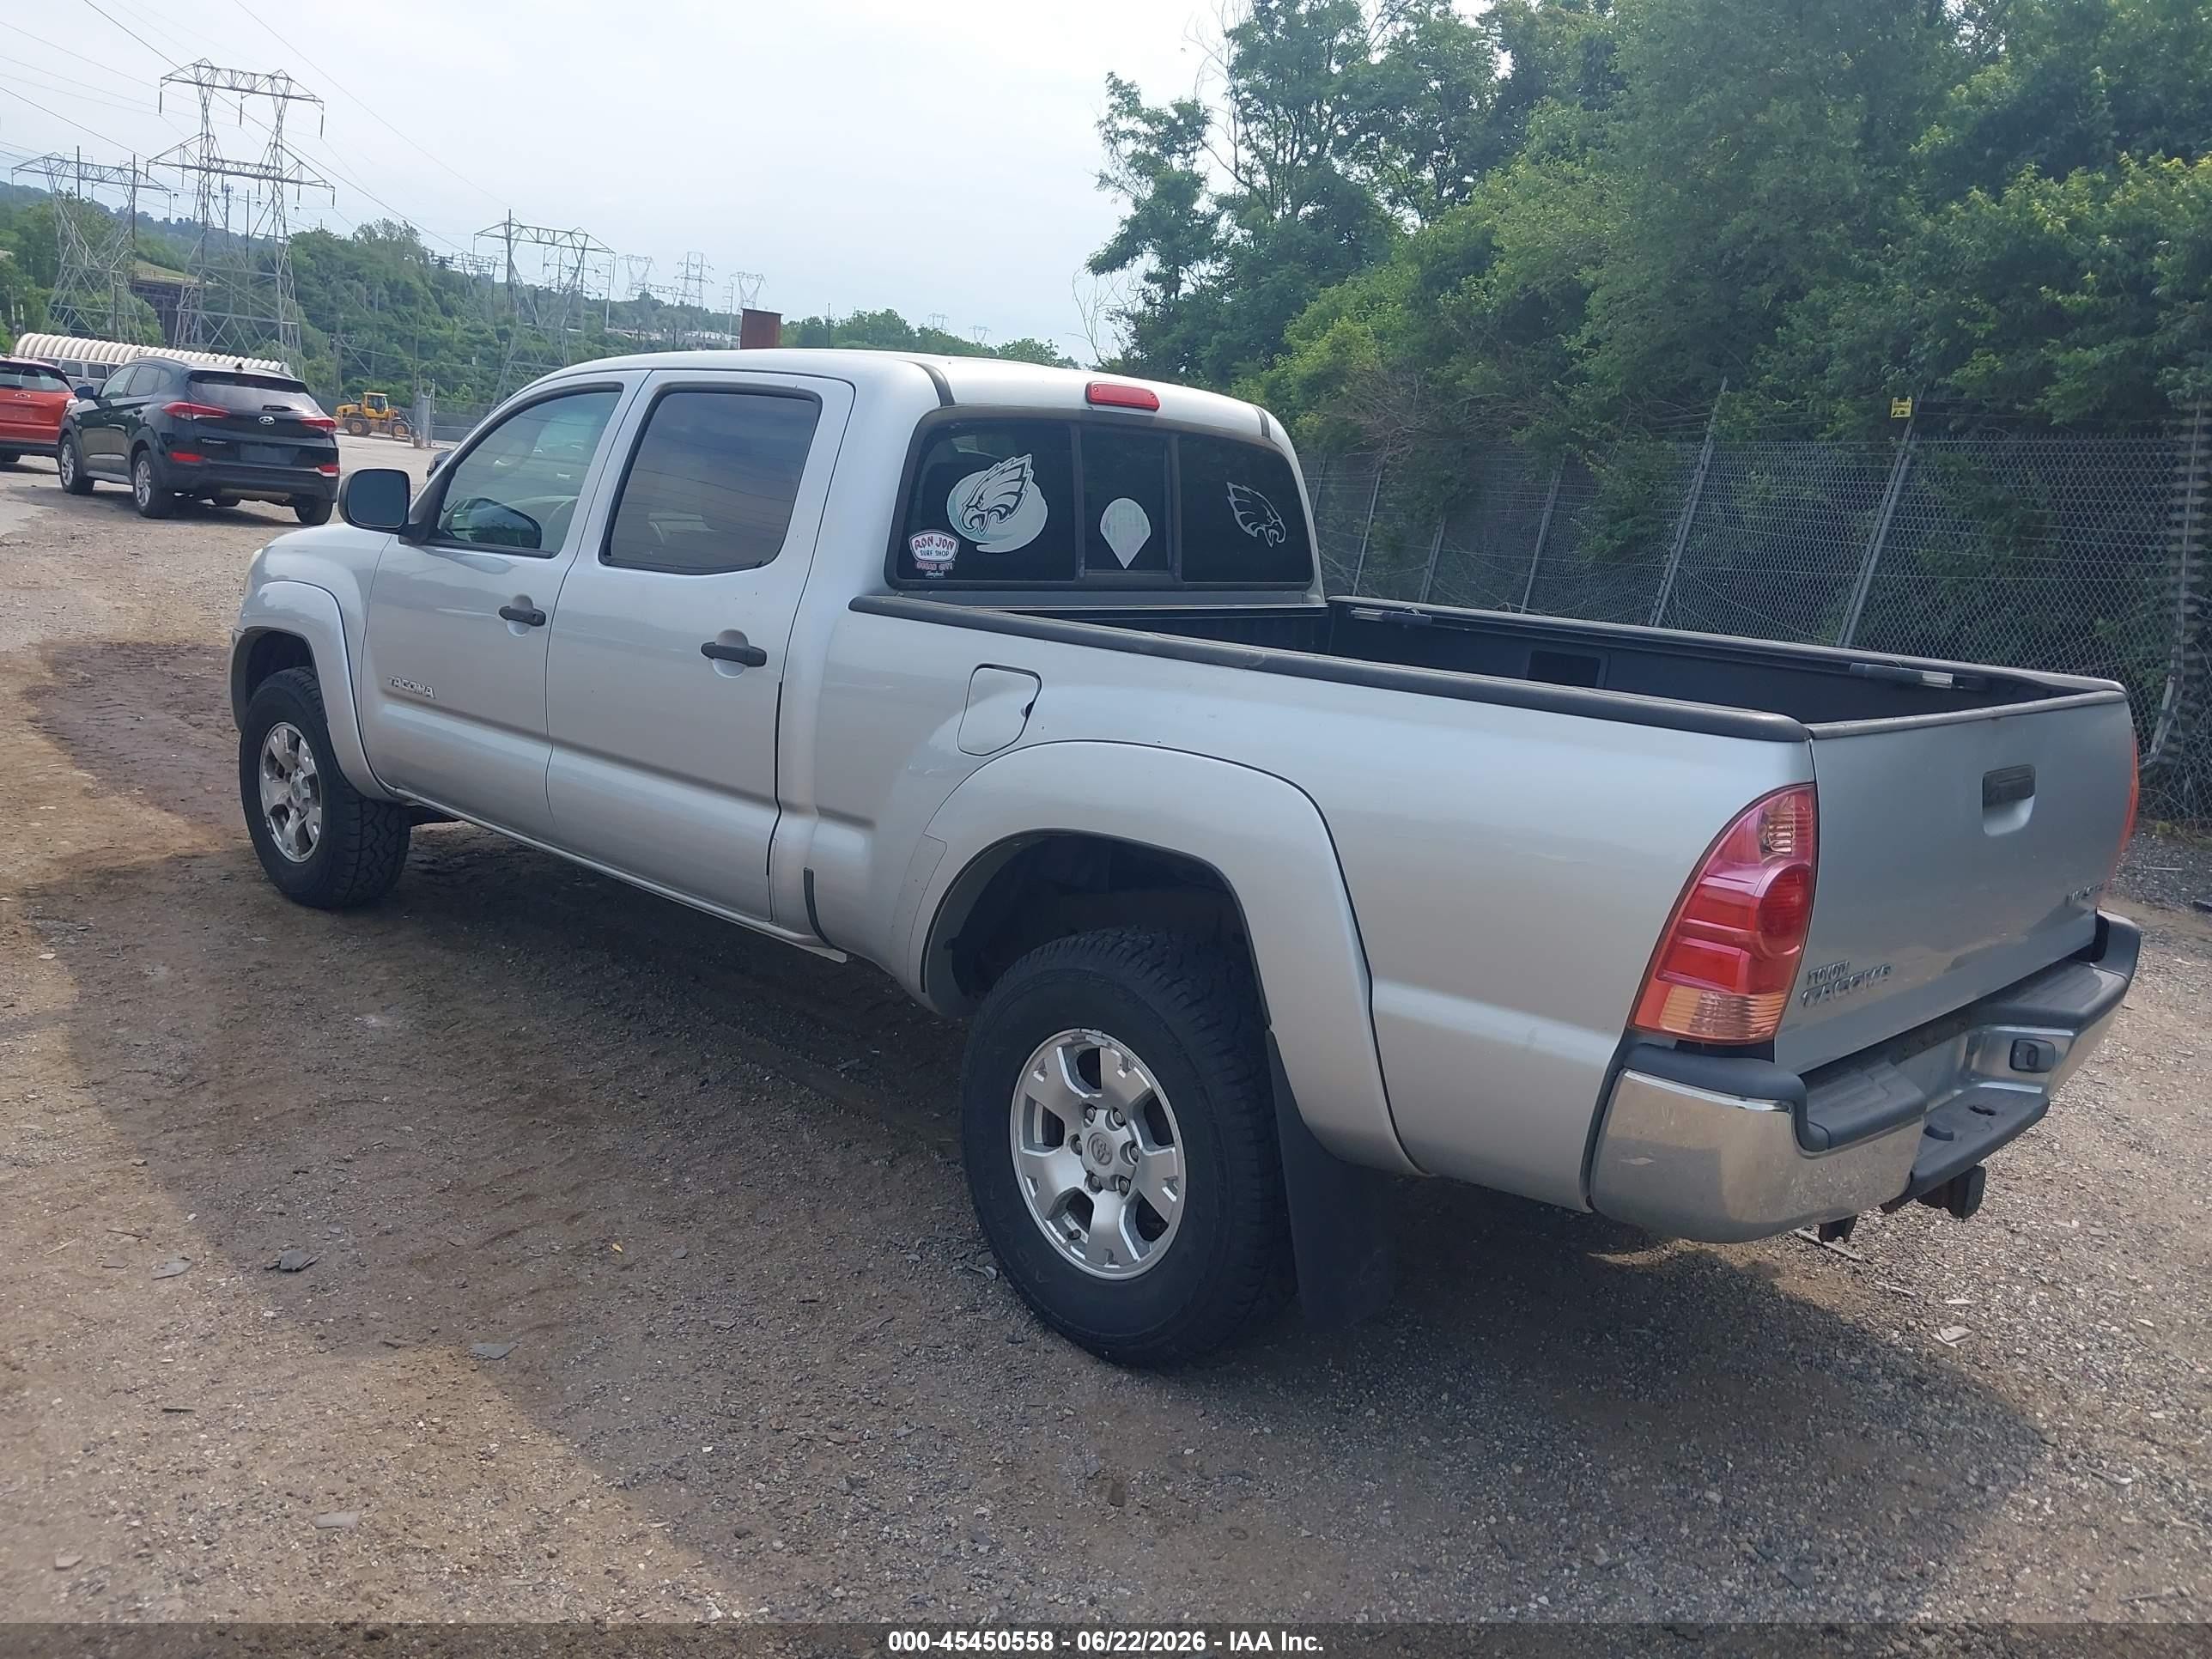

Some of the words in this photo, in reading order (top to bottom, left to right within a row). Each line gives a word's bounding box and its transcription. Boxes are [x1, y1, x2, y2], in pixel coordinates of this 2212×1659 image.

[915, 536, 934, 550] RON
[935, 537, 954, 550] JON
[387, 676, 435, 699] TACOMA
